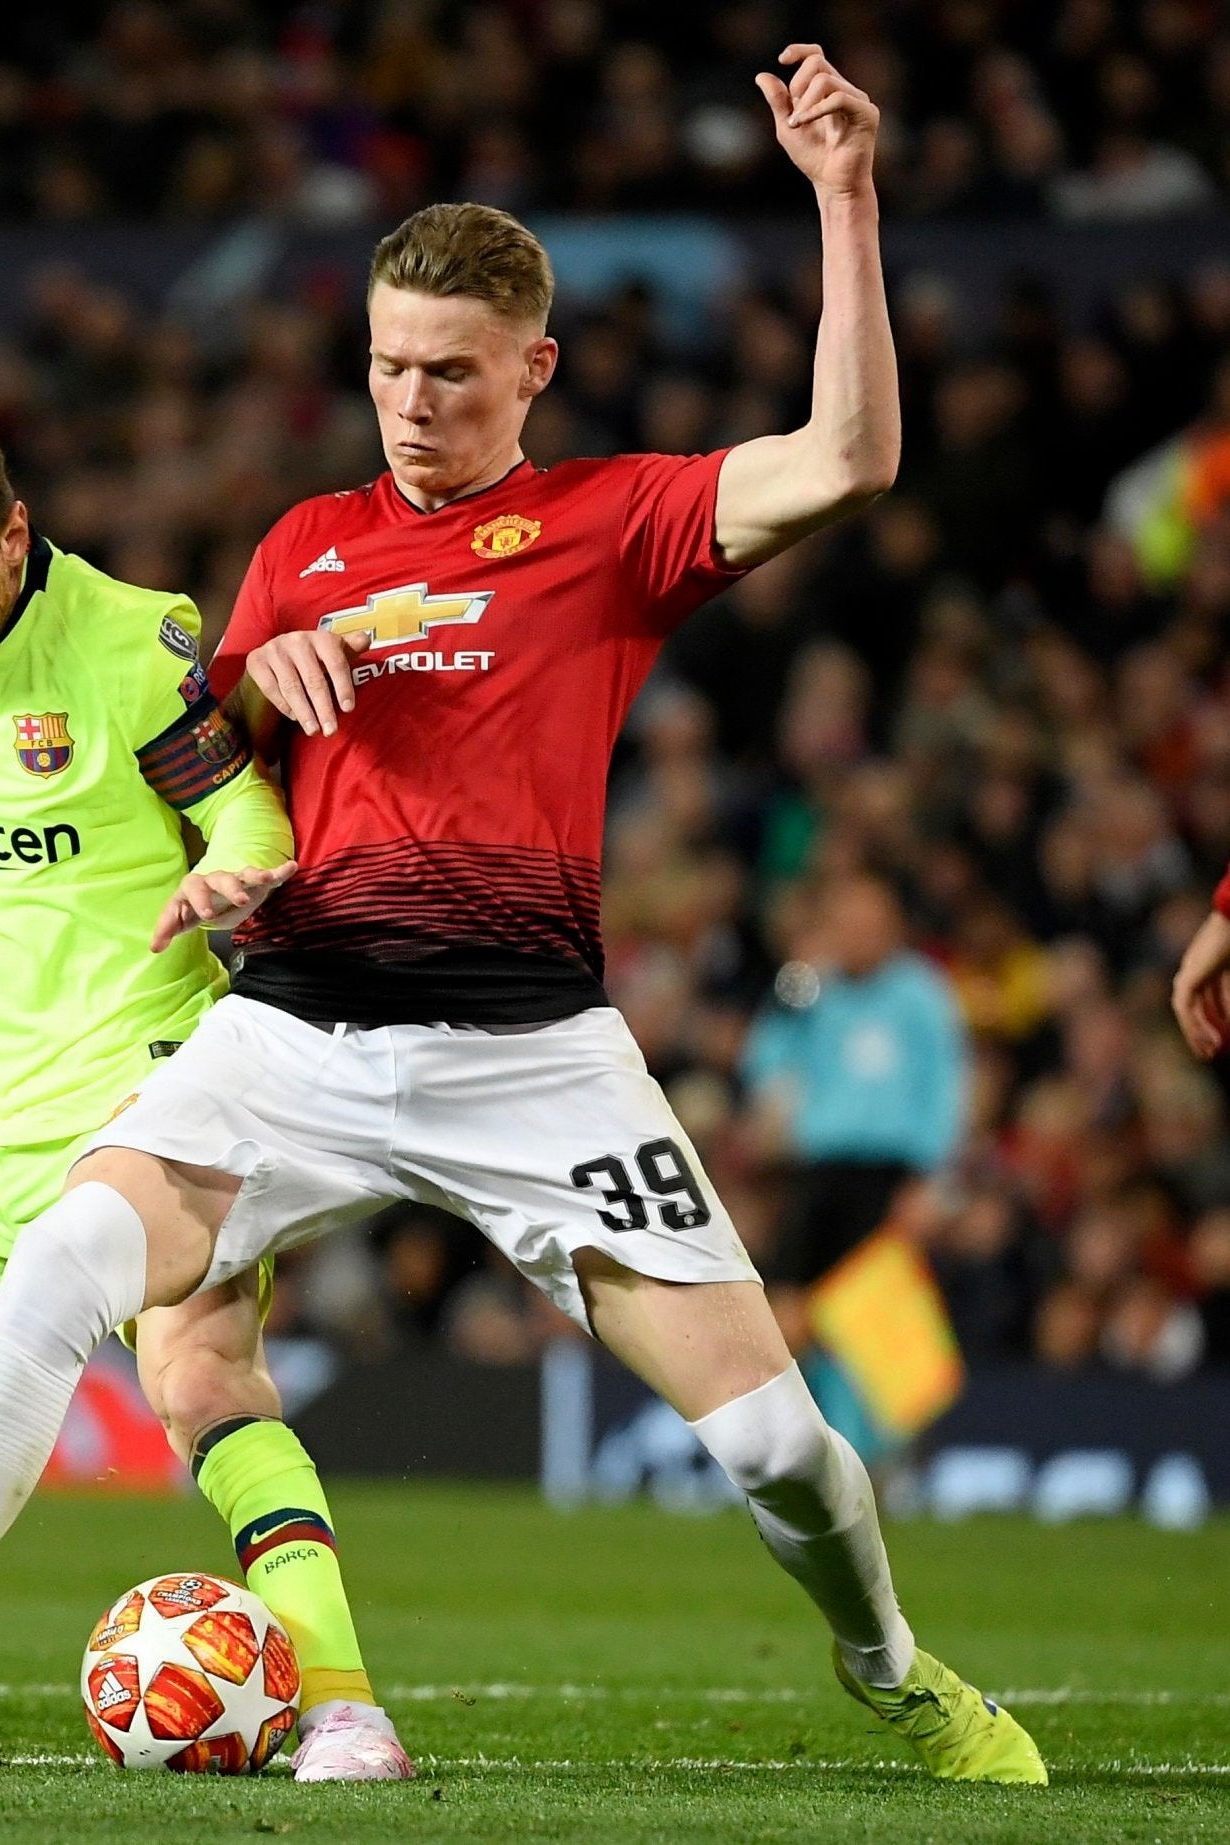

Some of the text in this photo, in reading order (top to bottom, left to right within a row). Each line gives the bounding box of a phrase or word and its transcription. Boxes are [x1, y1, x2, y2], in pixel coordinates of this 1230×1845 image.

[352, 651, 496, 687] EVROLET
[569, 1136, 711, 1233] 39
[264, 1548, 319, 1575] BARÇA
[97, 1689, 132, 1711] adidas
